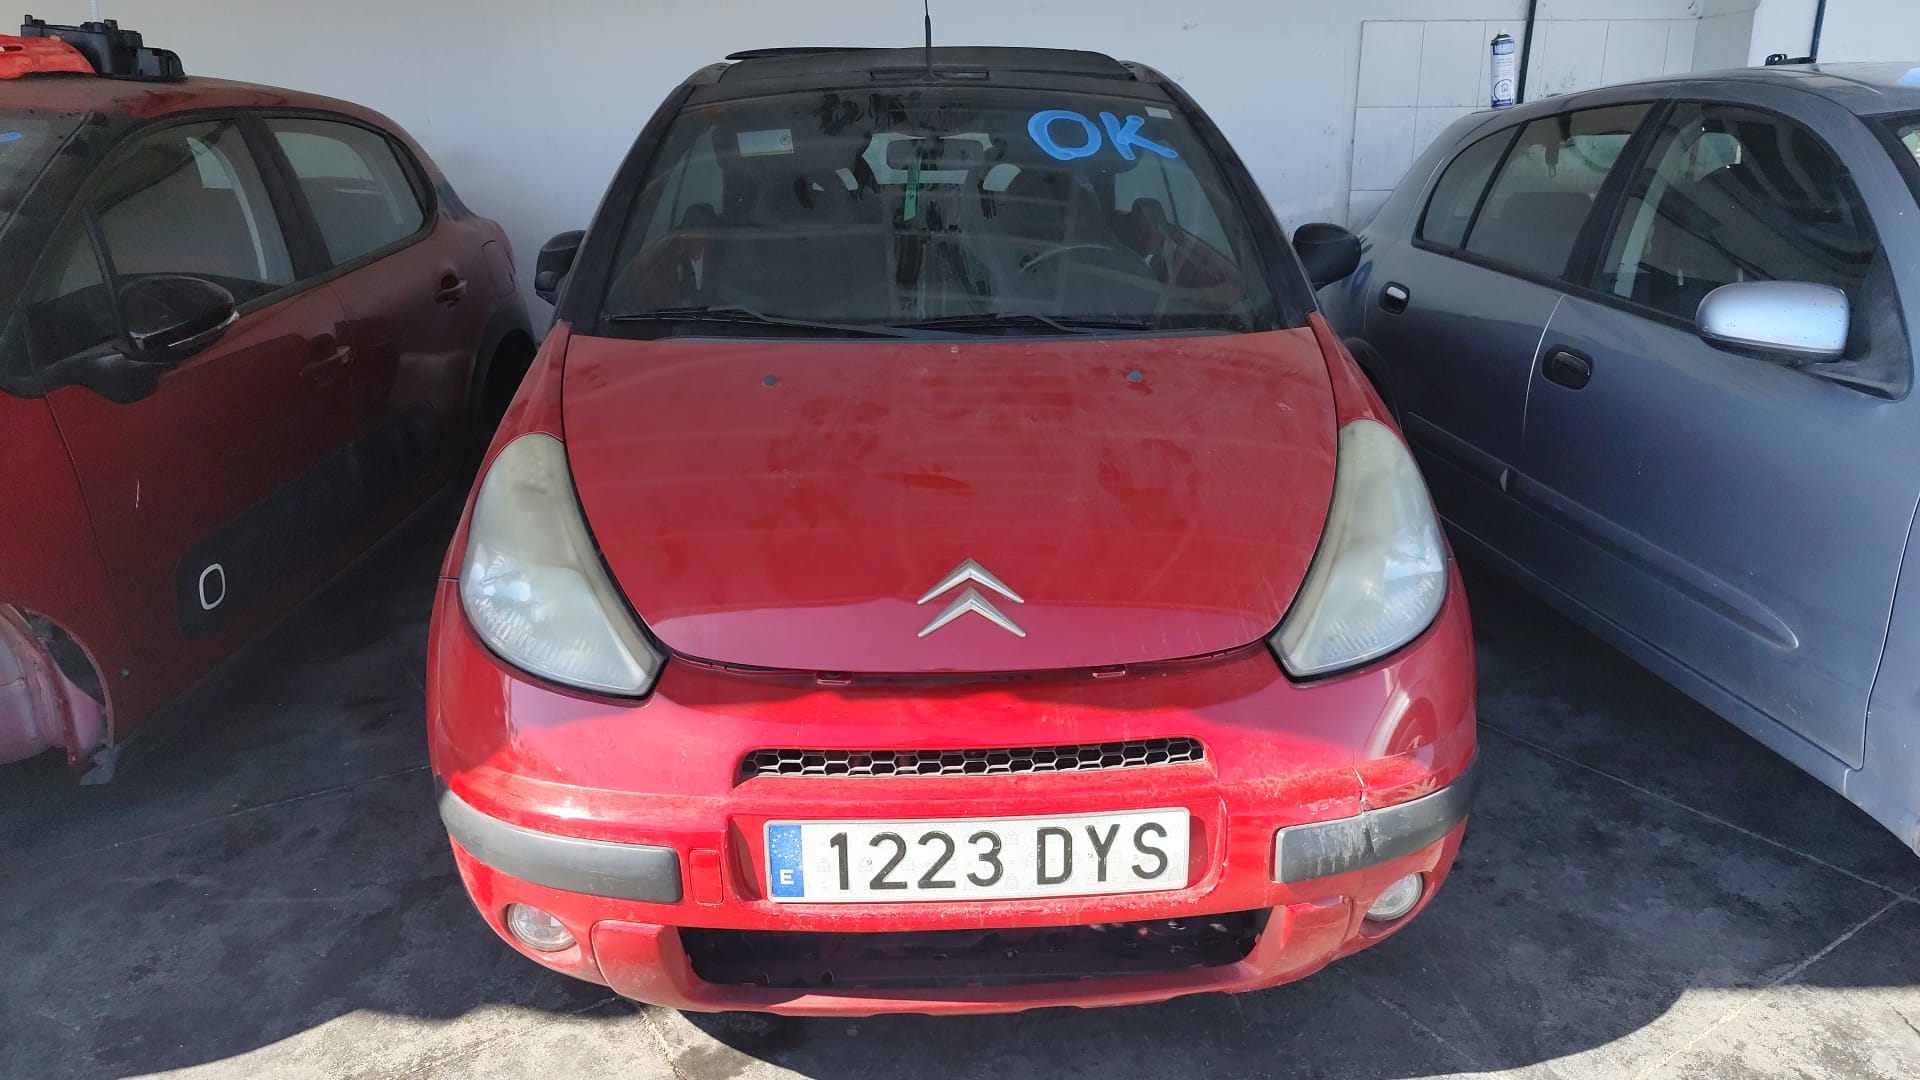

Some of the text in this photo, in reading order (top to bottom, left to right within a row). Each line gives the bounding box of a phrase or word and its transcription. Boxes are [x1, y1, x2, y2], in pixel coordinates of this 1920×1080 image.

[1028, 109, 1179, 161] OK
[779, 869, 795, 885] E
[829, 822, 1169, 891] 1223 DYS
